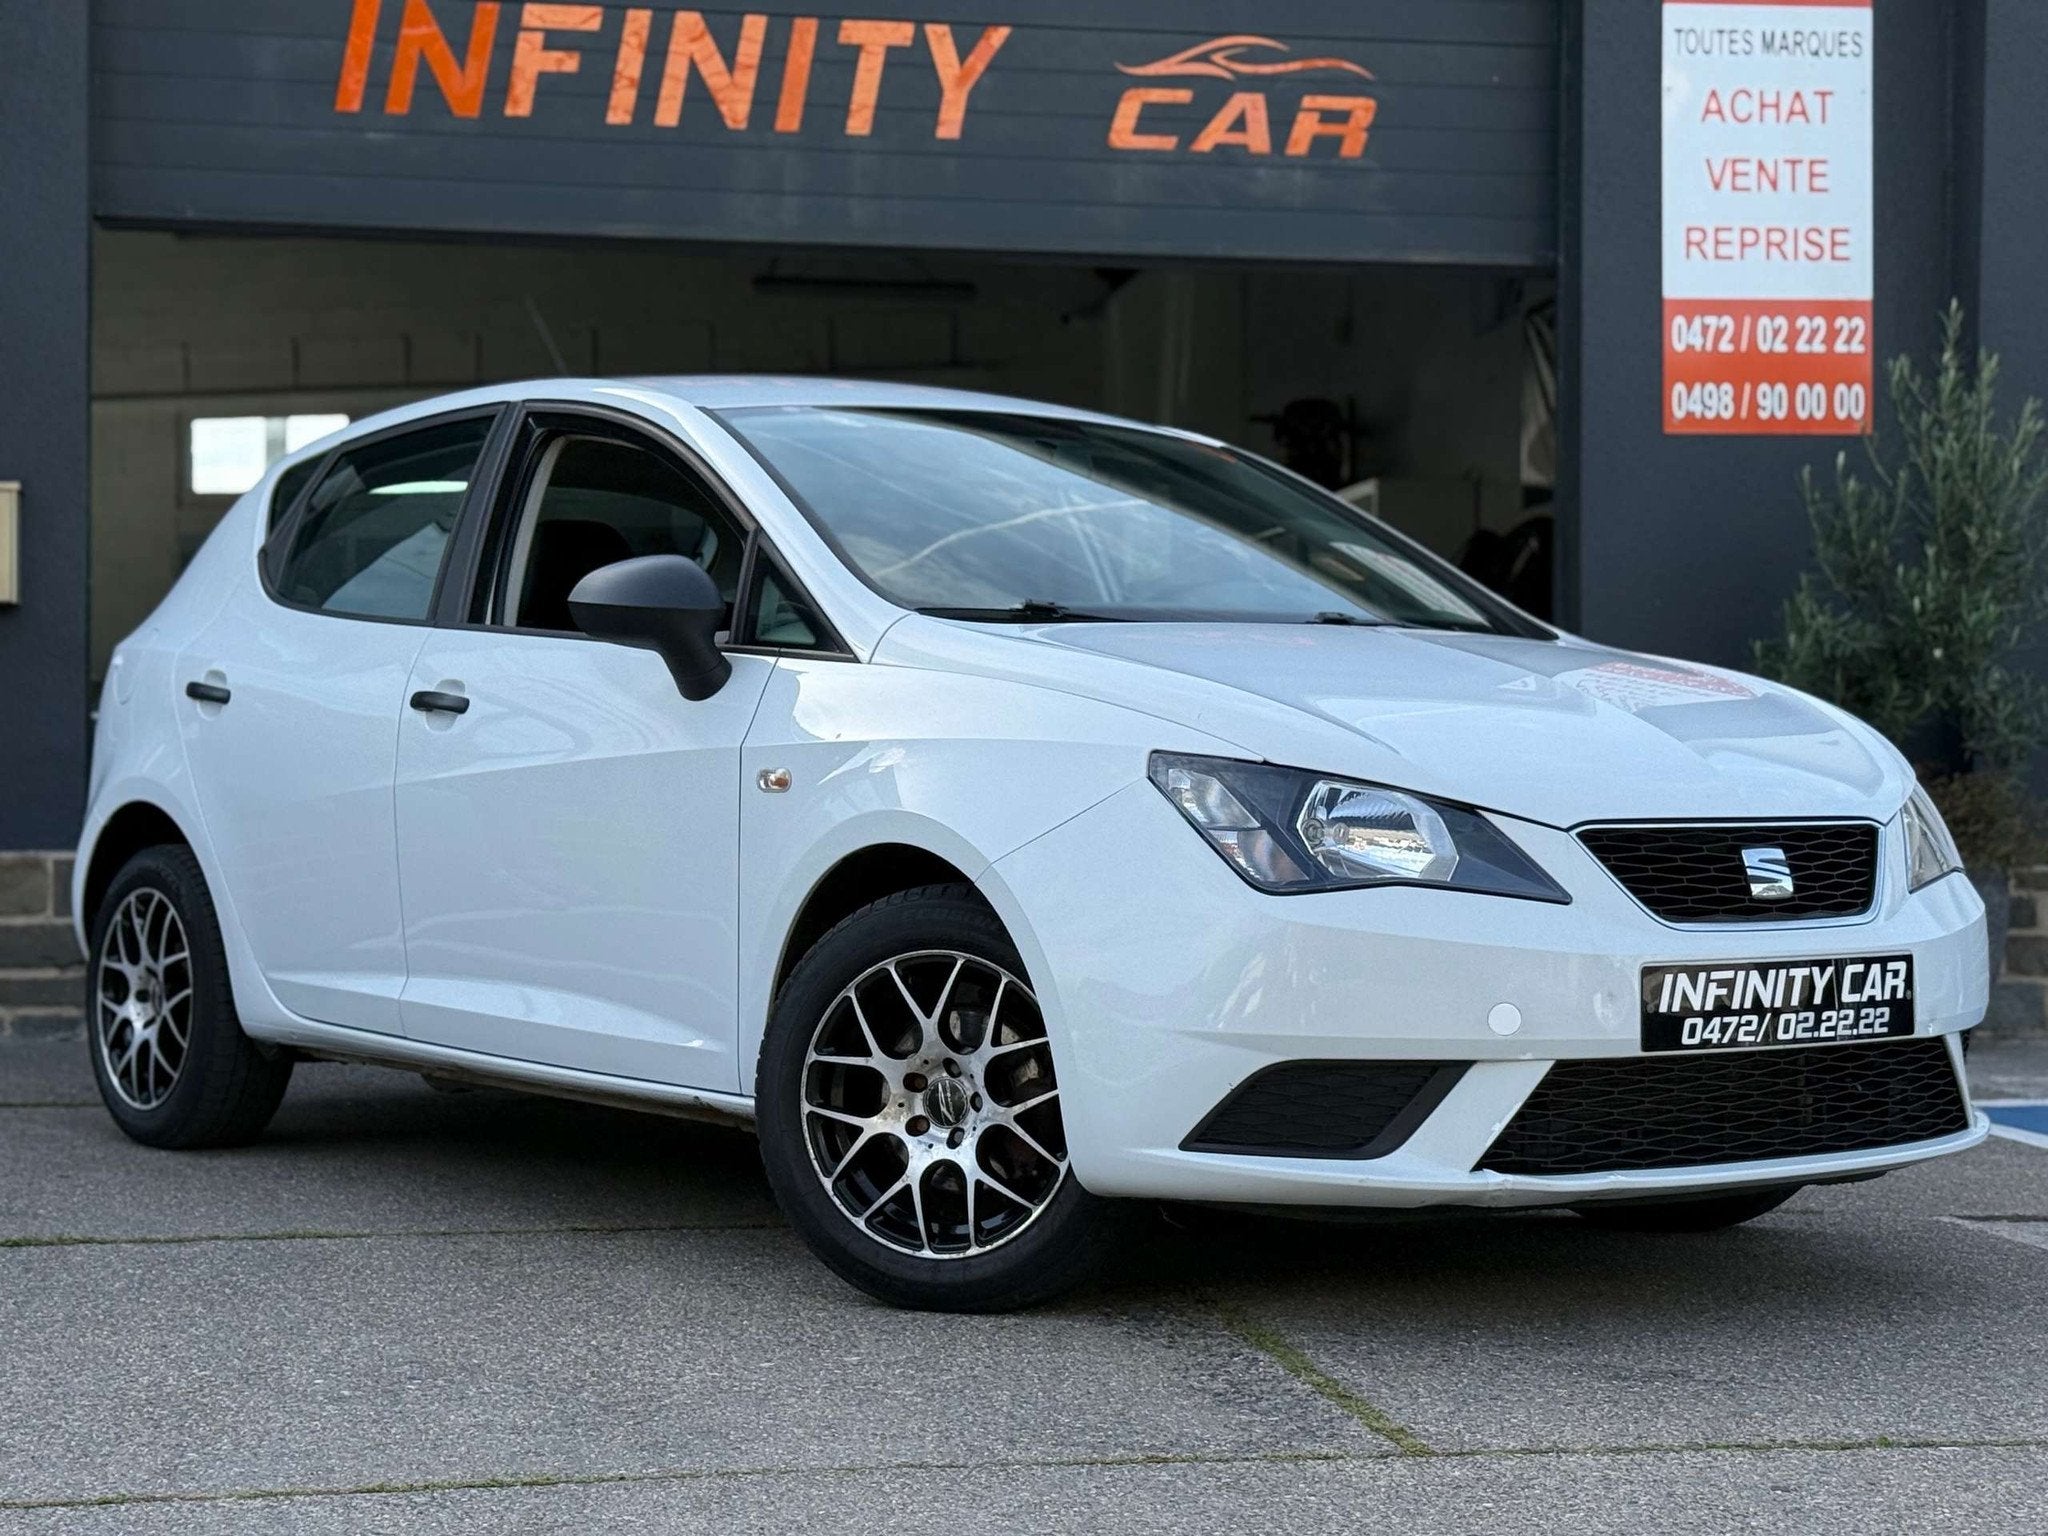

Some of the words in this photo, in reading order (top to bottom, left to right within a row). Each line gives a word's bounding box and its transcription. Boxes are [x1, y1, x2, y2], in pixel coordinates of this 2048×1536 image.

[1674, 29, 1753, 55] TOUTES
[1761, 31, 1863, 57] MARQUES
[334, 0, 1012, 139] INFINITY
[1107, 87, 1377, 159] CAR
[1701, 89, 1834, 124] ACHAT
[1706, 158, 1829, 193] VENTE
[1686, 227, 1851, 261] REPRISE
[1671, 314, 1735, 353] 0472
[1756, 315, 1789, 354] 02
[1795, 315, 1827, 354] 22
[1833, 316, 1866, 354] 22
[1671, 382, 1735, 420] 0498
[1756, 382, 1788, 420] 90
[1795, 383, 1827, 421] 00
[1833, 383, 1866, 421] 00
[1658, 966, 1835, 1013] INFINITY
[1841, 961, 1907, 1003] CAR
[1681, 1013, 1771, 1045] 0472/
[1777, 1007, 1890, 1040] 02.22.22
